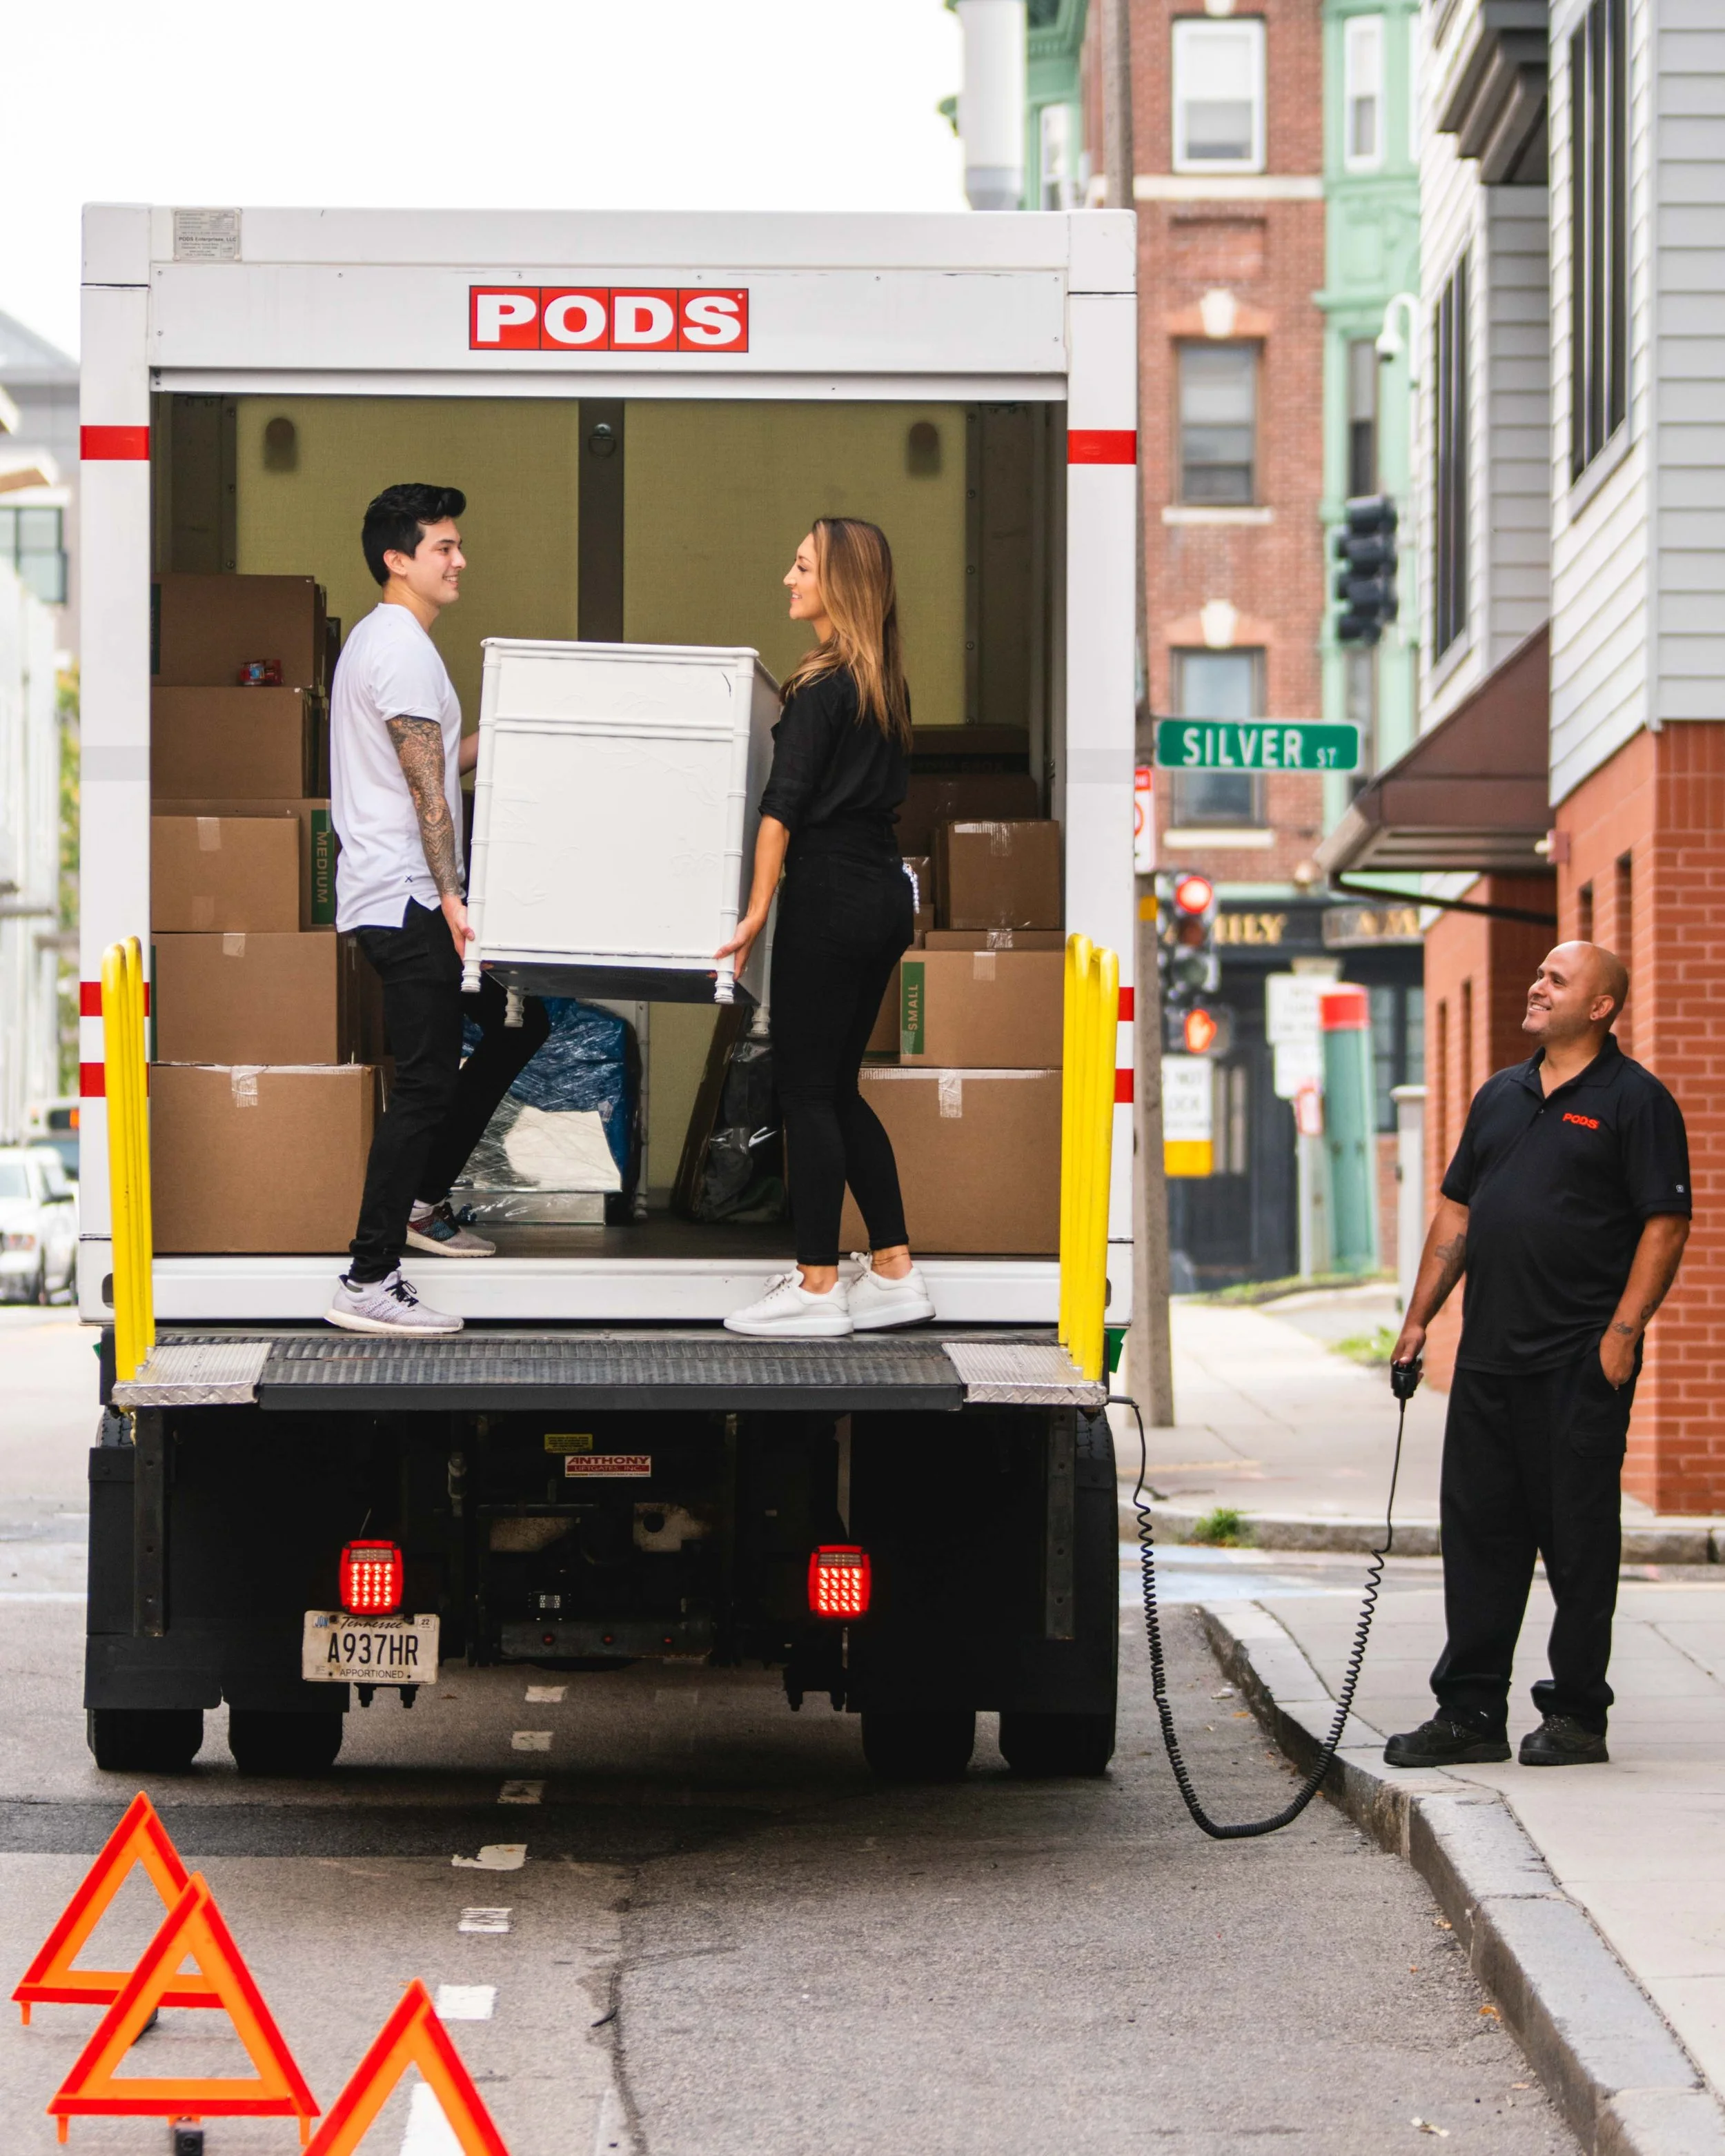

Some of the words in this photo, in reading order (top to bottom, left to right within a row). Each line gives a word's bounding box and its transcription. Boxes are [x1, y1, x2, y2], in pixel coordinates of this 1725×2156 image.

[477, 294, 742, 345] PODS
[1182, 727, 1303, 767] SILVER
[1316, 747, 1337, 767] ST
[316, 831, 328, 903] MEDIUM
[908, 984, 918, 1031] SMALL
[1562, 1112, 1599, 1129] PODS
[341, 1616, 404, 1630] Tennessee
[327, 1632, 419, 1665] A937HR
[339, 1668, 404, 1679] APPORTIONED
